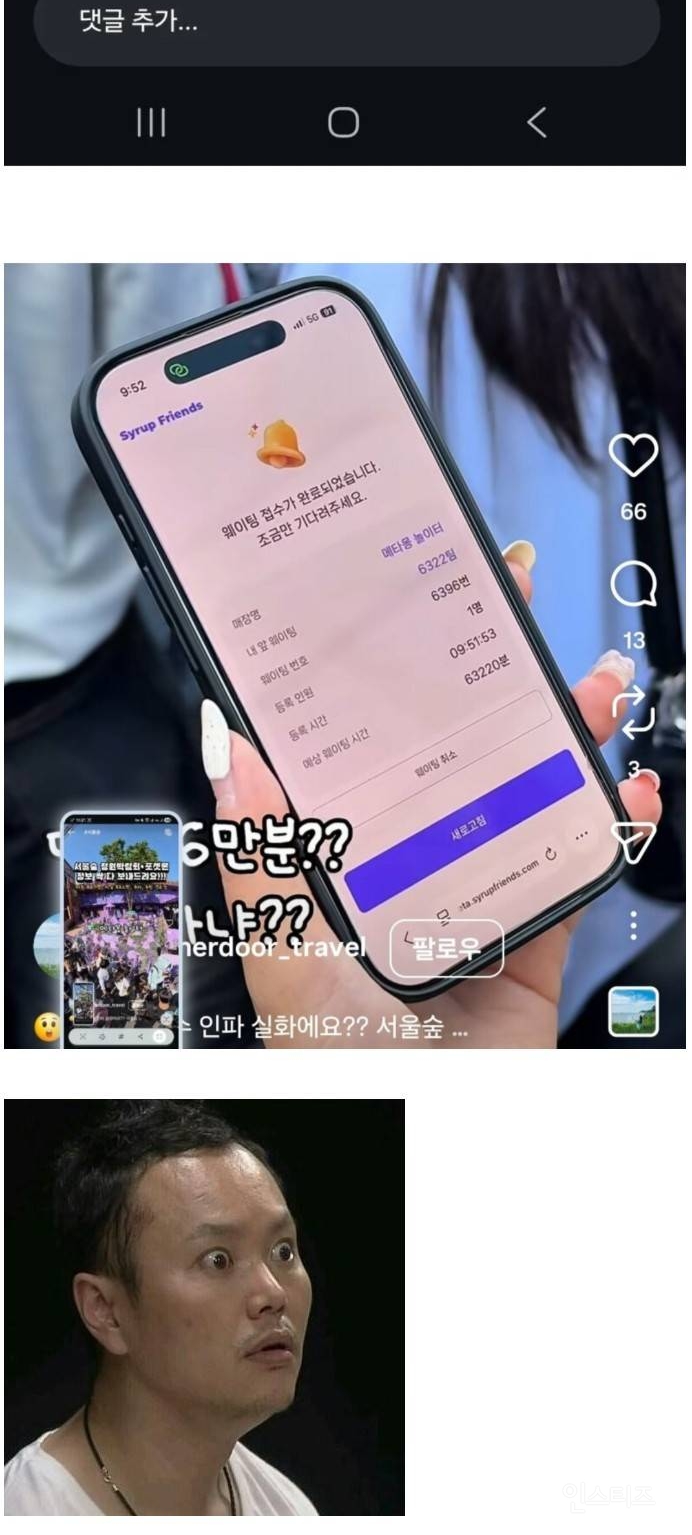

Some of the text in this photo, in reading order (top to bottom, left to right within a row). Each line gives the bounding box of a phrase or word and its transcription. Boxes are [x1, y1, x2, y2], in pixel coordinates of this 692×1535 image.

[119, 380, 148, 398] 9:52
[119, 400, 204, 442] Syrup Friends
[221, 511, 261, 540] 웨이팅
[260, 495, 297, 523] 접수가
[258, 523, 295, 548] 조금만
[431, 574, 471, 602] 6396번
[466, 601, 484, 616] 1명
[310, 714, 328, 732] 시간
[449, 628, 497, 659] 09:51:53
[351, 727, 370, 744] 시간
[464, 654, 511, 685] 63220분
